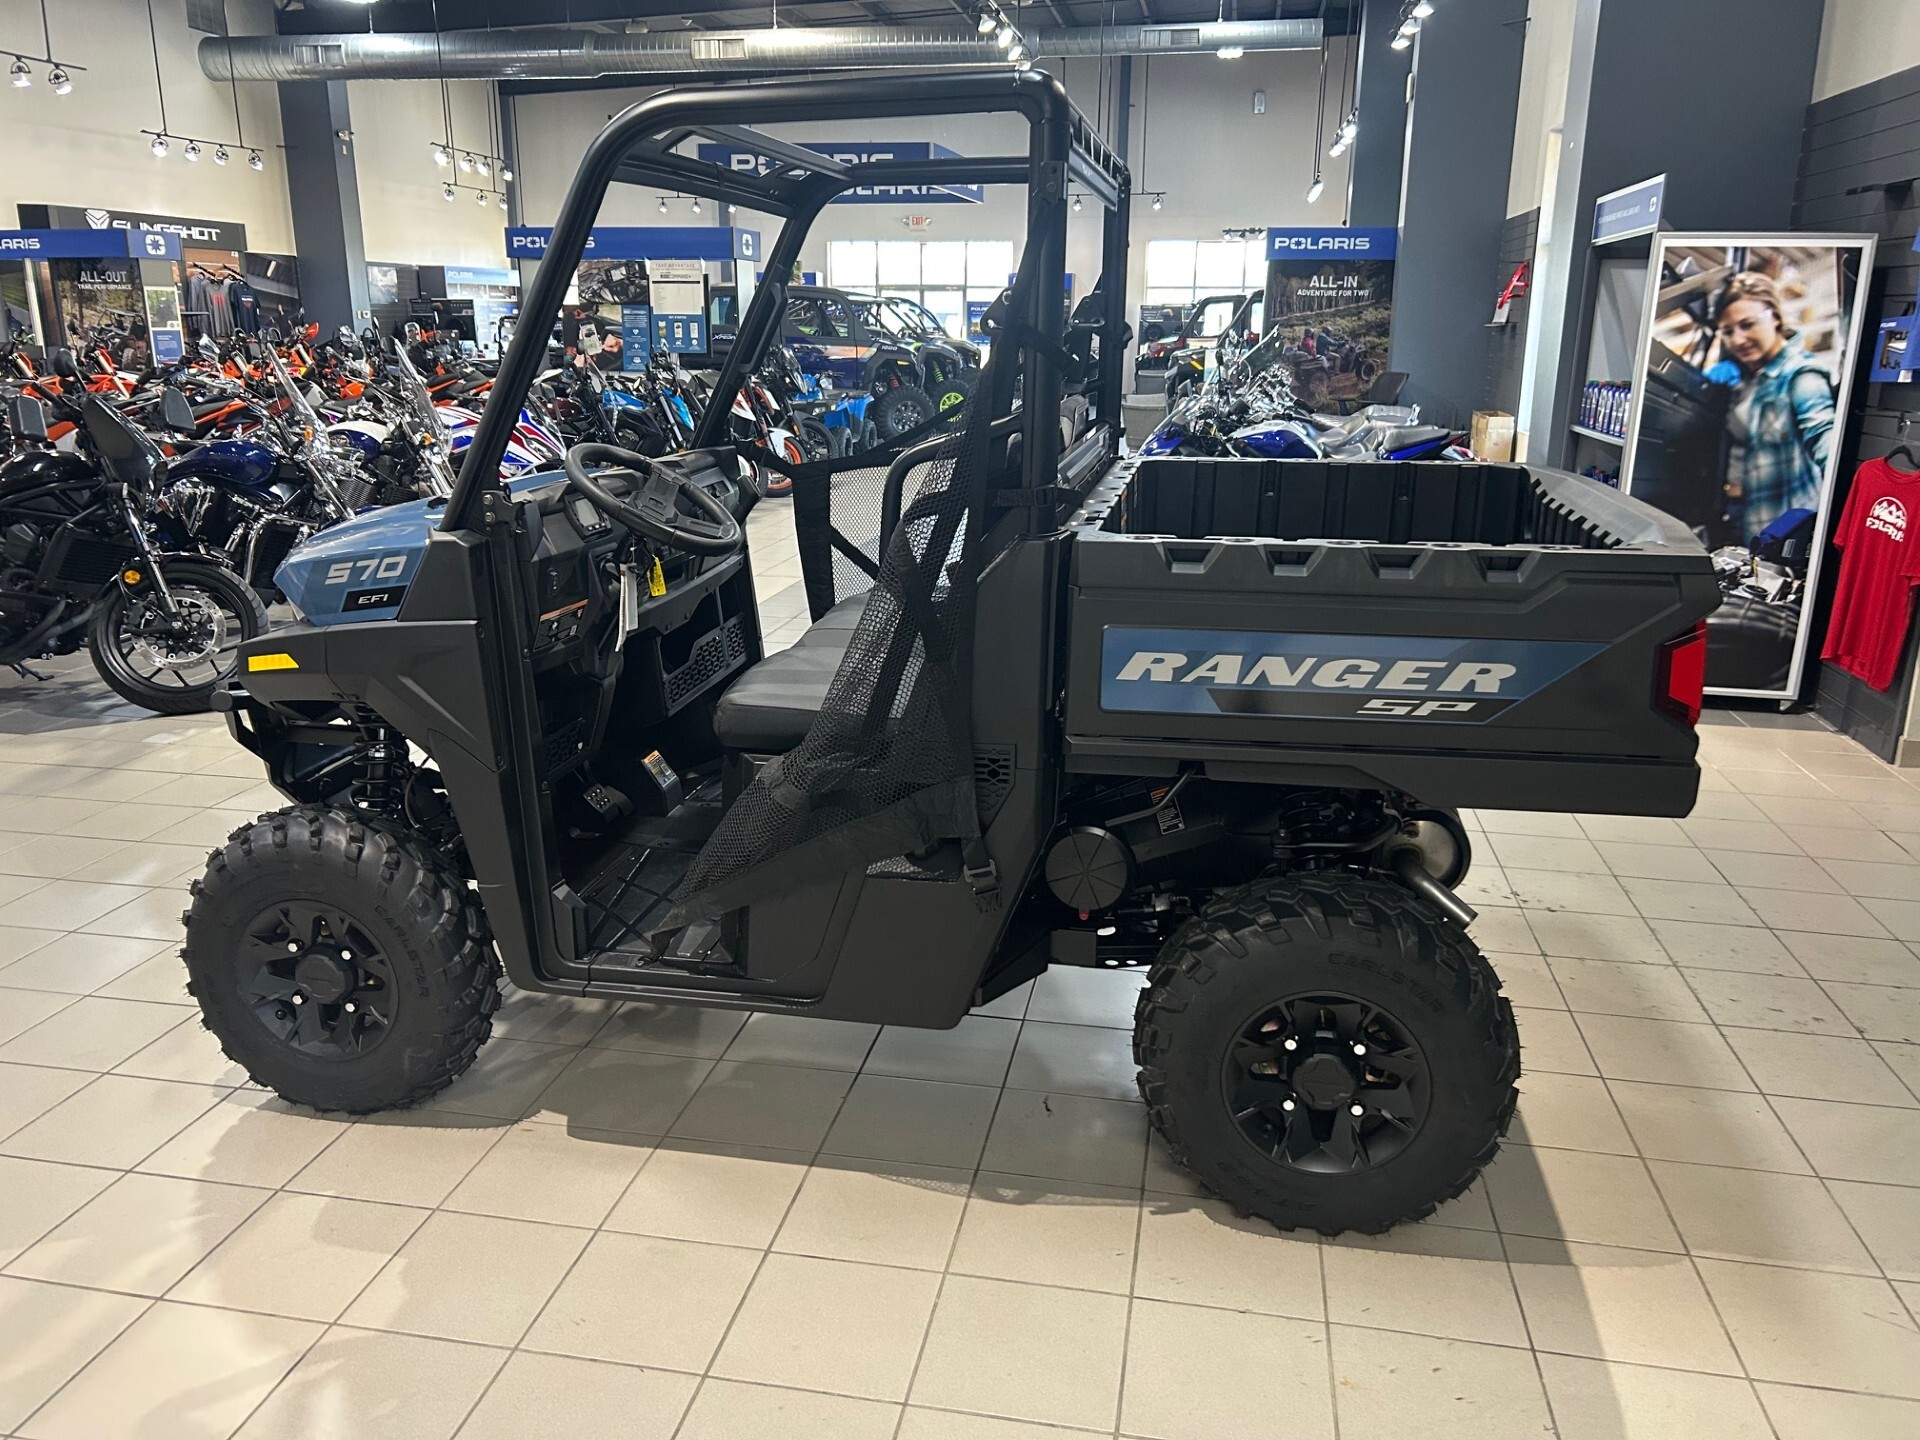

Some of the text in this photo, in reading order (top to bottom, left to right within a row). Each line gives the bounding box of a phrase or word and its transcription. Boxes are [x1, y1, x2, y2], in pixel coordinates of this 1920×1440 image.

[911, 216, 924, 226] EXIT
[0, 238, 41, 249] ARIS
[512, 236, 596, 249] POLS
[1274, 237, 1370, 250] POLARIS
[80, 270, 127, 283] ALL-OUT
[1309, 275, 1359, 288] ALL-IN
[1296, 288, 1369, 297] ADVENTURE FOR TWO
[323, 555, 408, 585] 570
[357, 593, 389, 605] EFI
[1115, 651, 1518, 694] RANGER
[1356, 698, 1478, 717] SP
